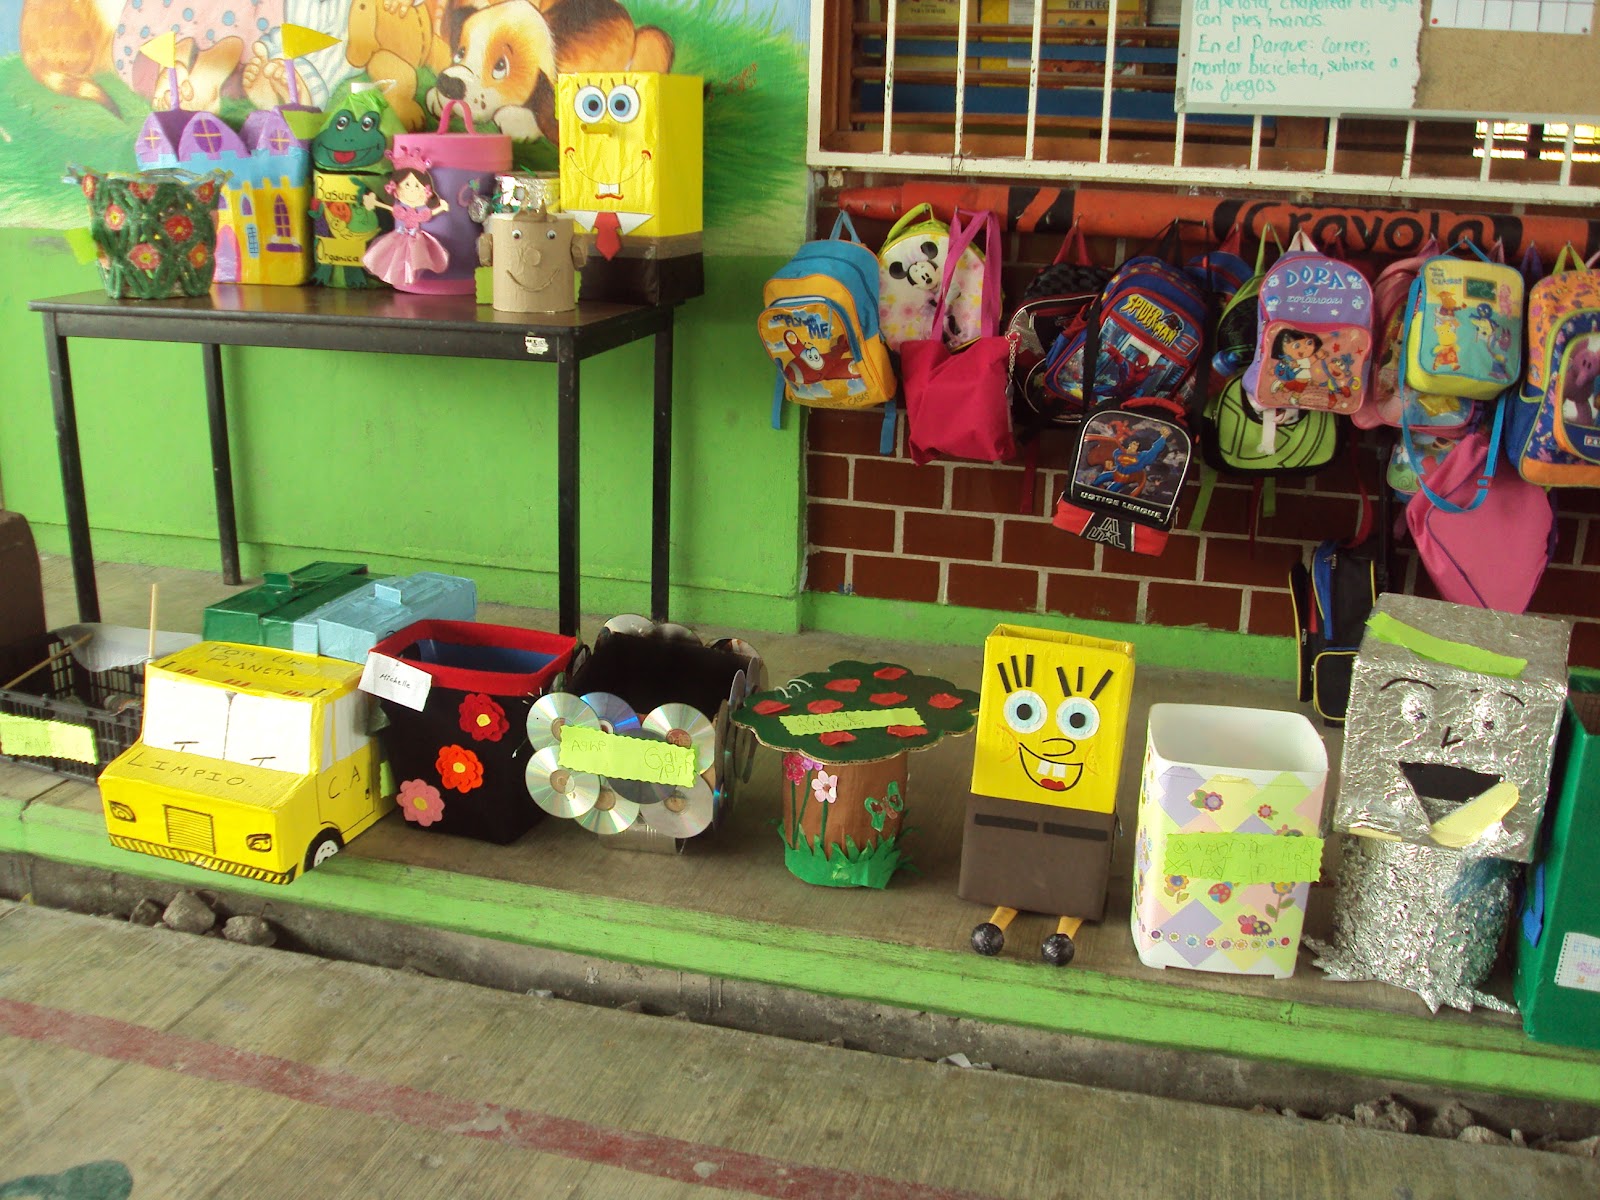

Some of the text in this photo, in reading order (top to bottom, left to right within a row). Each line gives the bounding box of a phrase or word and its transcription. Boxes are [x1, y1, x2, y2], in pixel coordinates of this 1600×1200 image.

[1085, 0, 1109, 9] FUEG
[1196, 14, 1222, 27] con
[1198, 34, 1221, 54] En
[1226, 36, 1241, 53] el
[1192, 58, 1243, 76] montar
[1250, 52, 1325, 80] bicicleta,
[1328, 57, 1377, 74] subirse
[1190, 76, 1278, 102] los juegos
[316, 175, 357, 200] Basura
[1244, 202, 1490, 252] Crayola
[1286, 265, 1347, 290] DORA
[808, 322, 831, 340] ME
[205, 654, 295, 677] PLANETA
[379, 673, 411, 689] Michelle
